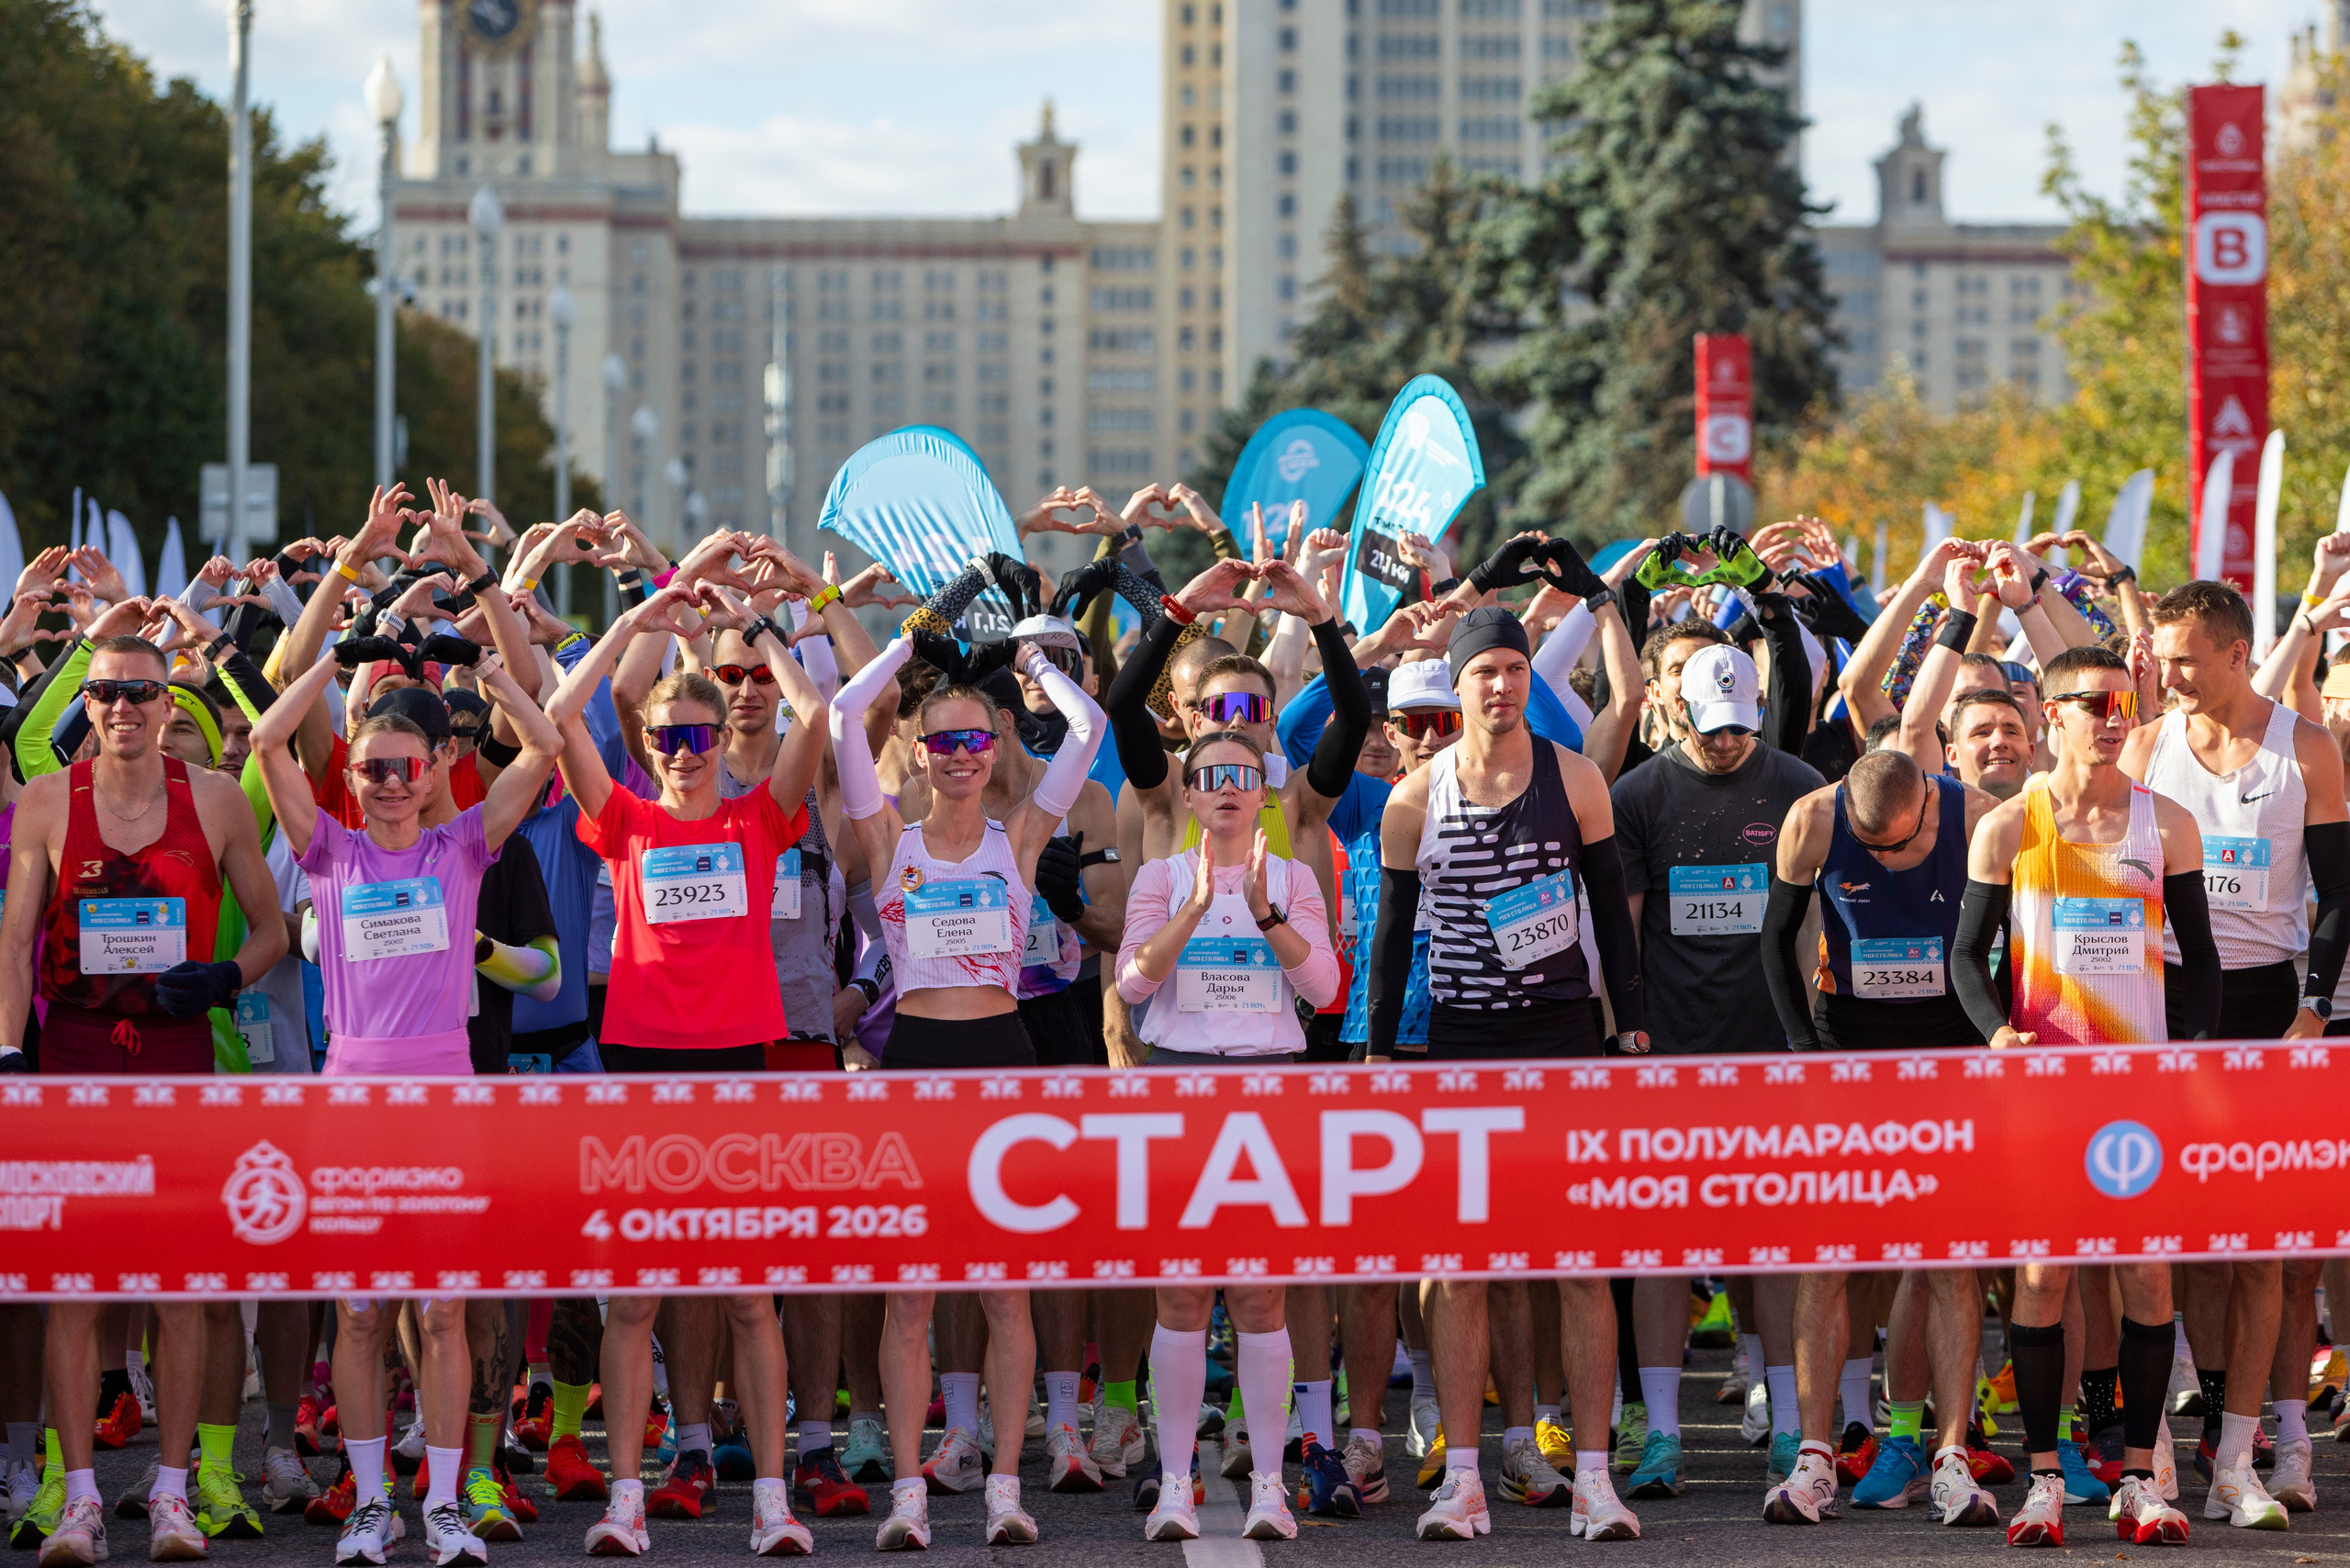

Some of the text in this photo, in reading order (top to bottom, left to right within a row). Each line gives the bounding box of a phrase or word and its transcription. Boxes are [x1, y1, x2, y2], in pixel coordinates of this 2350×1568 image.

[2212, 229, 2248, 269] B
[1745, 829, 1774, 837] SATISFY
[2222, 850, 2233, 860] A
[665, 866, 693, 874] СТОЛИЦА
[1724, 877, 1734, 887] A
[2203, 875, 2242, 894] 176
[655, 883, 725, 907] 23923
[1541, 893, 1550, 902] A+
[927, 901, 956, 909] СТОЛИЦА
[1498, 902, 1538, 922] МОЯ СТОЛИЦА
[1685, 902, 1743, 919] 21134
[360, 915, 421, 930] Симакова
[932, 916, 977, 928] Седова
[100, 933, 157, 946] Трошкин
[364, 926, 421, 941] Светлана
[936, 929, 973, 938] Елена
[1507, 913, 1569, 952] 23870
[383, 938, 404, 946] 25007
[2074, 934, 2128, 946] Крыслов
[103, 945, 154, 955] Алексей
[2072, 945, 2129, 958] Дмитрий
[1201, 971, 1250, 981] Власова
[1863, 969, 1935, 986] 23384
[1205, 982, 1245, 994] Дарья
[1566, 1118, 1975, 1164] IX ПОЛУМАРАФОН
[579, 1131, 923, 1193] МОСКВА
[968, 1106, 1525, 1235] СТАРТ
[1566, 1168, 1940, 1211] «МОЯ СТОЛИЦА»
[0, 1195, 66, 1230] ПОРТ
[581, 1204, 929, 1242] 4 ОКТЯБРЯ 2026
